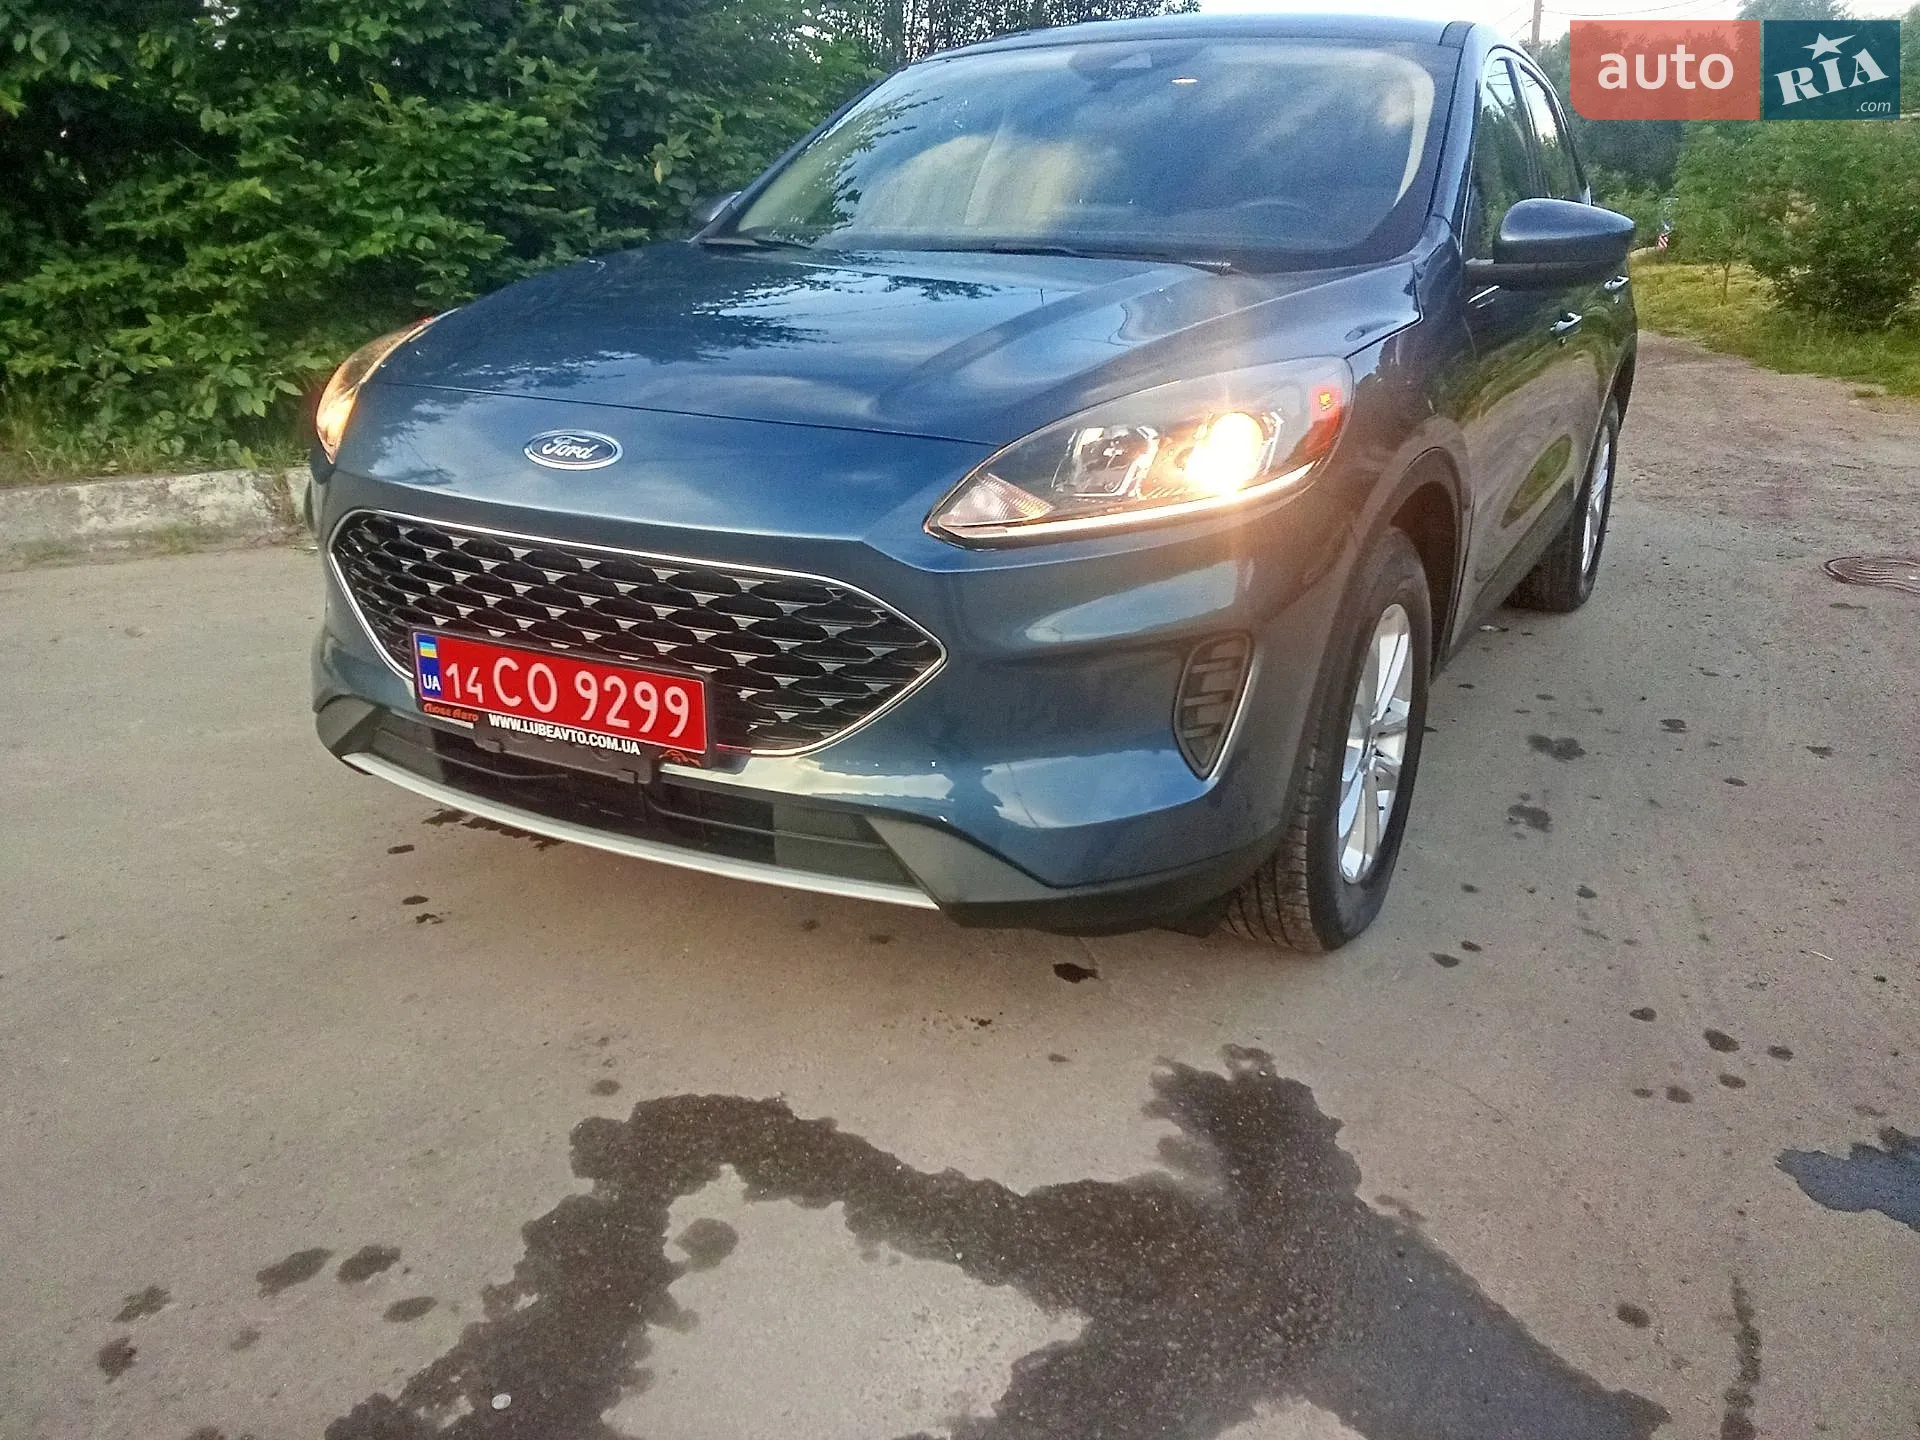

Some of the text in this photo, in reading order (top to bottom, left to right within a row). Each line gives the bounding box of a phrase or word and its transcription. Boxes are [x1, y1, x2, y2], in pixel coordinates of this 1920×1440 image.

[541, 435, 600, 460] Ford
[422, 674, 441, 691] UA
[573, 669, 690, 739] 9299
[487, 712, 642, 756] WWW.LUBEAVTO.COM.UA
